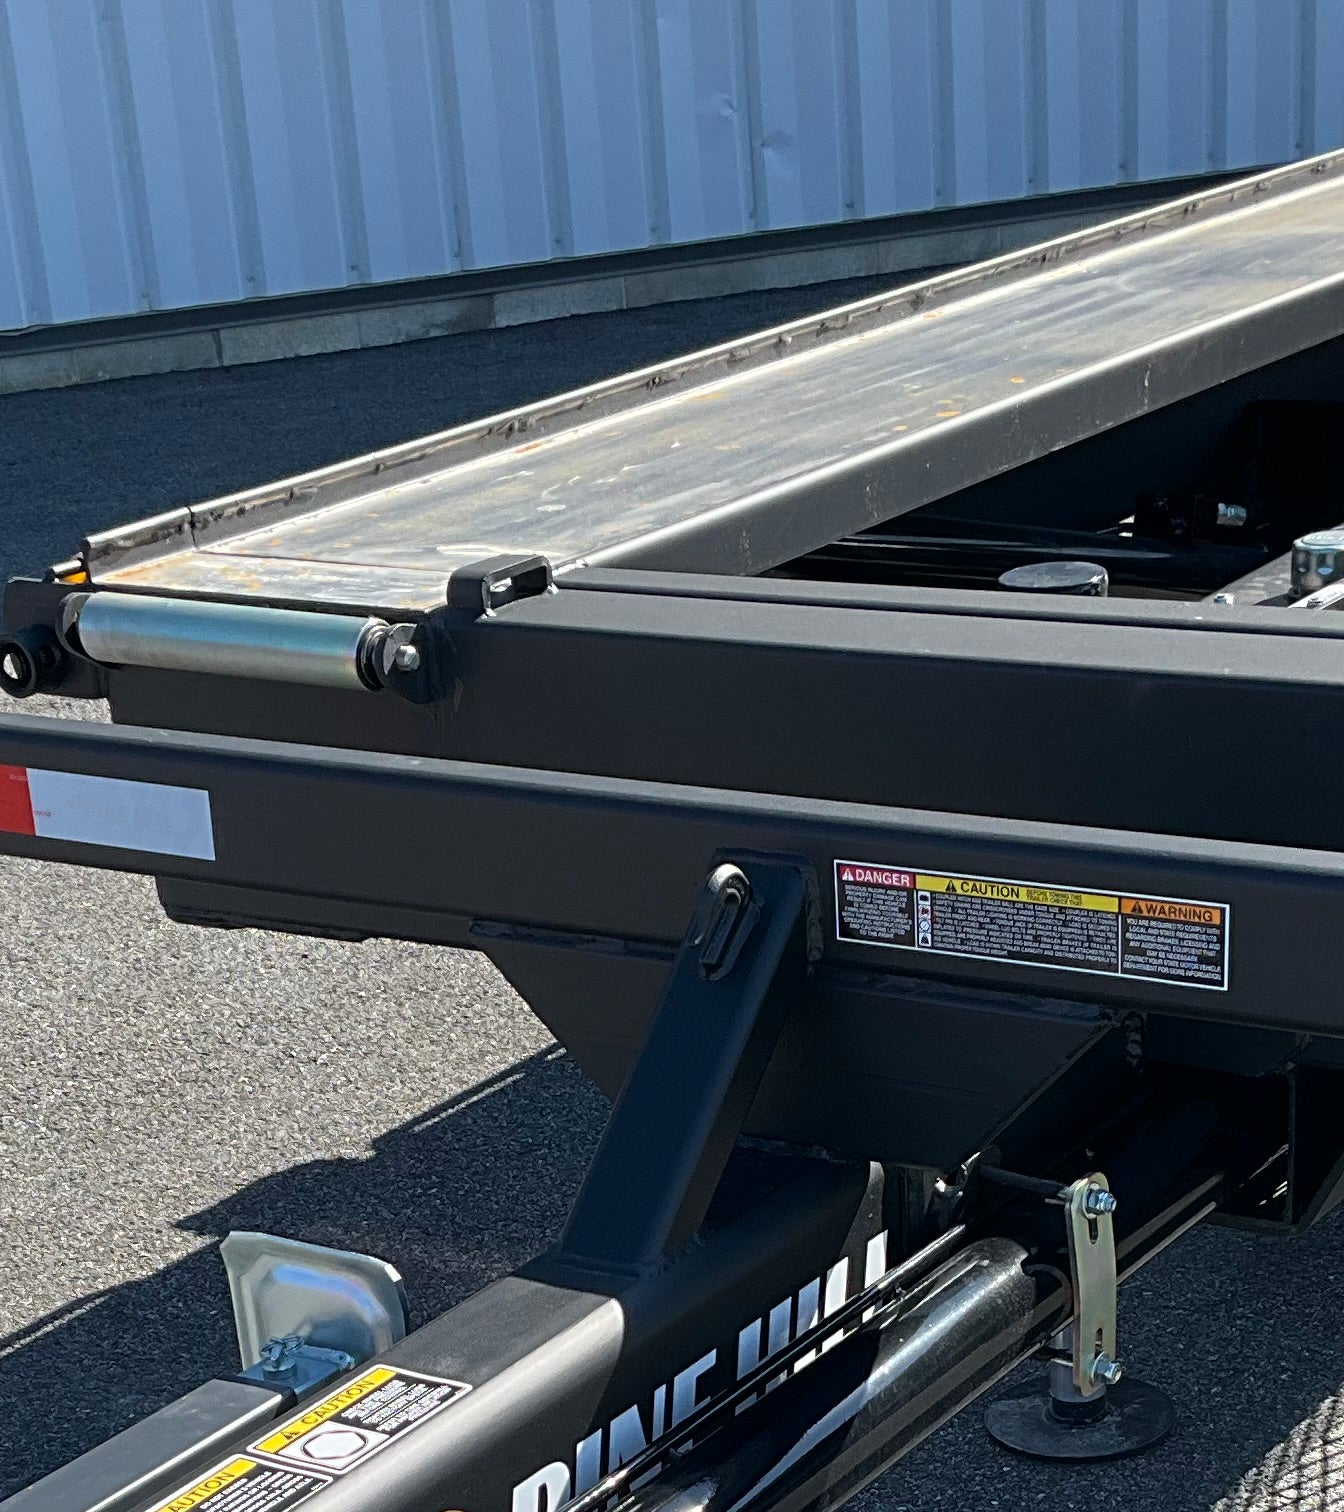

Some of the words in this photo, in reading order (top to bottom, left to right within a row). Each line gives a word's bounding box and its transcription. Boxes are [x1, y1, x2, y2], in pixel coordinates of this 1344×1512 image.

[855, 868, 910, 887] DANGER
[960, 881, 1020, 899] CAUTION
[1145, 902, 1213, 922] WARNING
[298, 1379, 376, 1426] CAUTION
